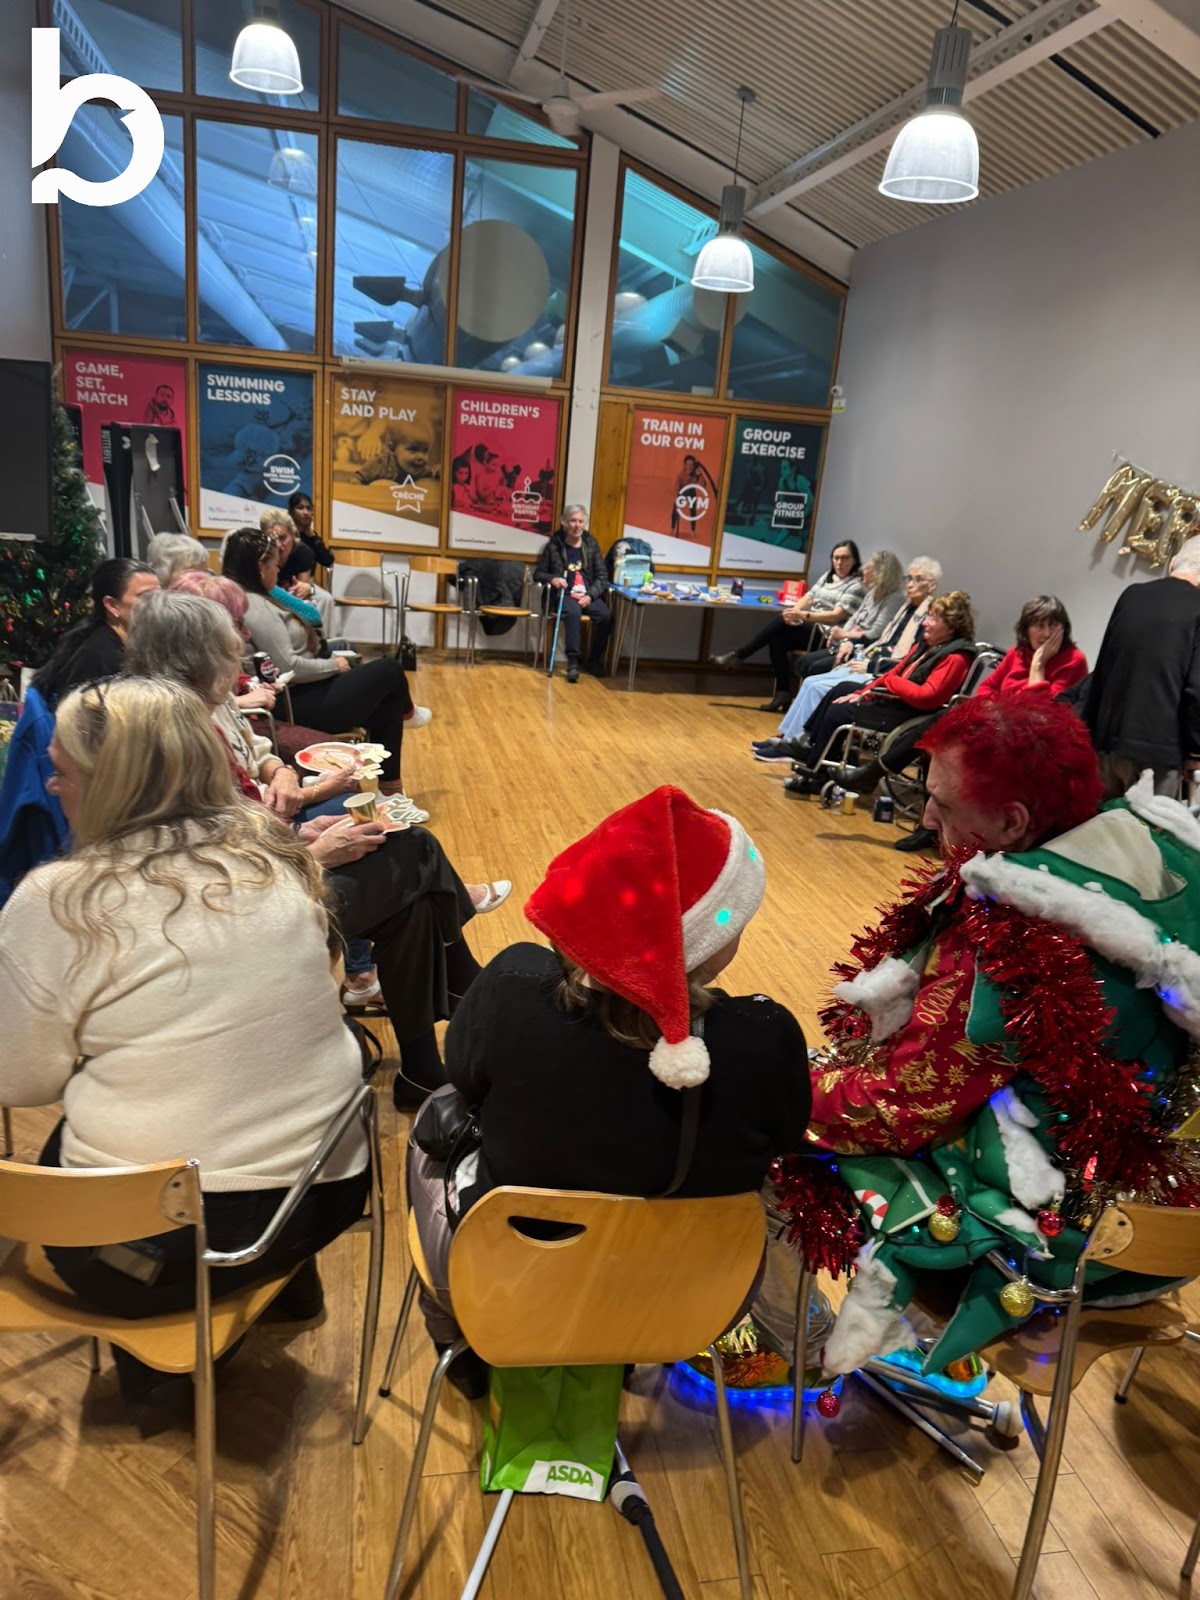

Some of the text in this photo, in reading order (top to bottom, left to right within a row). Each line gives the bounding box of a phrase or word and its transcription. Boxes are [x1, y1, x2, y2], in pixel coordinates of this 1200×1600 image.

[75, 362, 124, 379] GAME,
[76, 376, 105, 391] SET,
[206, 374, 286, 393] SWIMMING
[76, 390, 129, 406] MATCH
[207, 388, 272, 405] LESSONS
[340, 387, 377, 403] STAY
[340, 403, 417, 422] AND PLAY
[460, 400, 540, 419] CHILDREN'S
[460, 413, 514, 429] PARTIES
[642, 418, 703, 436] TRAIN IN
[640, 432, 705, 451] OUR GYM
[743, 428, 791, 444] GROUP
[741, 442, 806, 460] EXERCISE
[270, 466, 294, 475] SWIM
[392, 490, 425, 501] CRÈCHE
[675, 495, 709, 510] GYM
[773, 509, 805, 518] FITNESS
[775, 502, 805, 510] GROUP
[546, 1464, 594, 1487] ASDA
